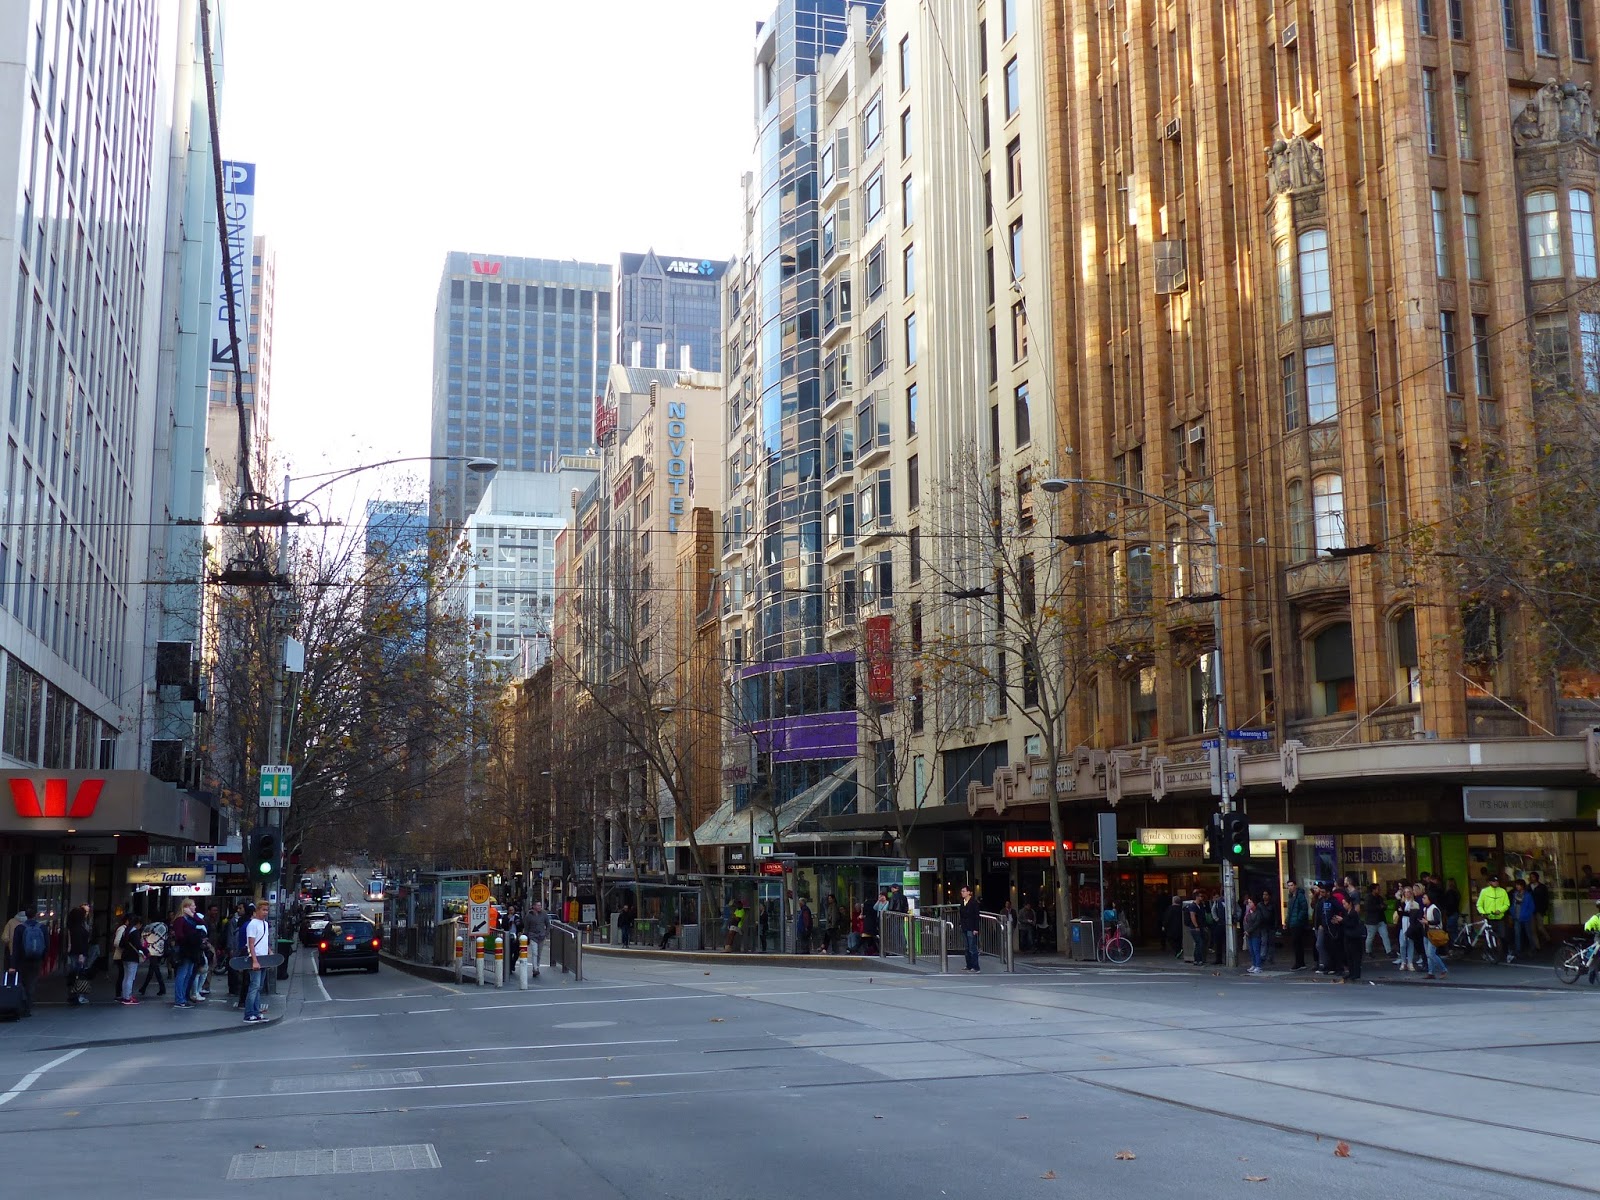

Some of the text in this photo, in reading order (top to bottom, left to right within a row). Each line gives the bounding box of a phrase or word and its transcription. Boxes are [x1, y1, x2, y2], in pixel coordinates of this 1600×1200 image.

[225, 165, 248, 192] P
[218, 201, 247, 322] PARKING
[667, 260, 699, 274] ANZ
[668, 401, 686, 534] NOVOTEL
[1239, 730, 1262, 738] Swanston
[263, 766, 290, 774] FAIRWAY
[1034, 764, 1073, 780] MANSTER
[1180, 772, 1203, 782] COLLINS
[1055, 779, 1077, 793] RCADE
[1493, 800, 1509, 809] HOW
[1511, 800, 1521, 809] WE
[986, 834, 1002, 844] BOSS
[1315, 839, 1335, 849] MORE
[1008, 845, 1056, 853] MERREL
[160, 871, 188, 882] Tatts
[172, 886, 194, 894] OPSM
